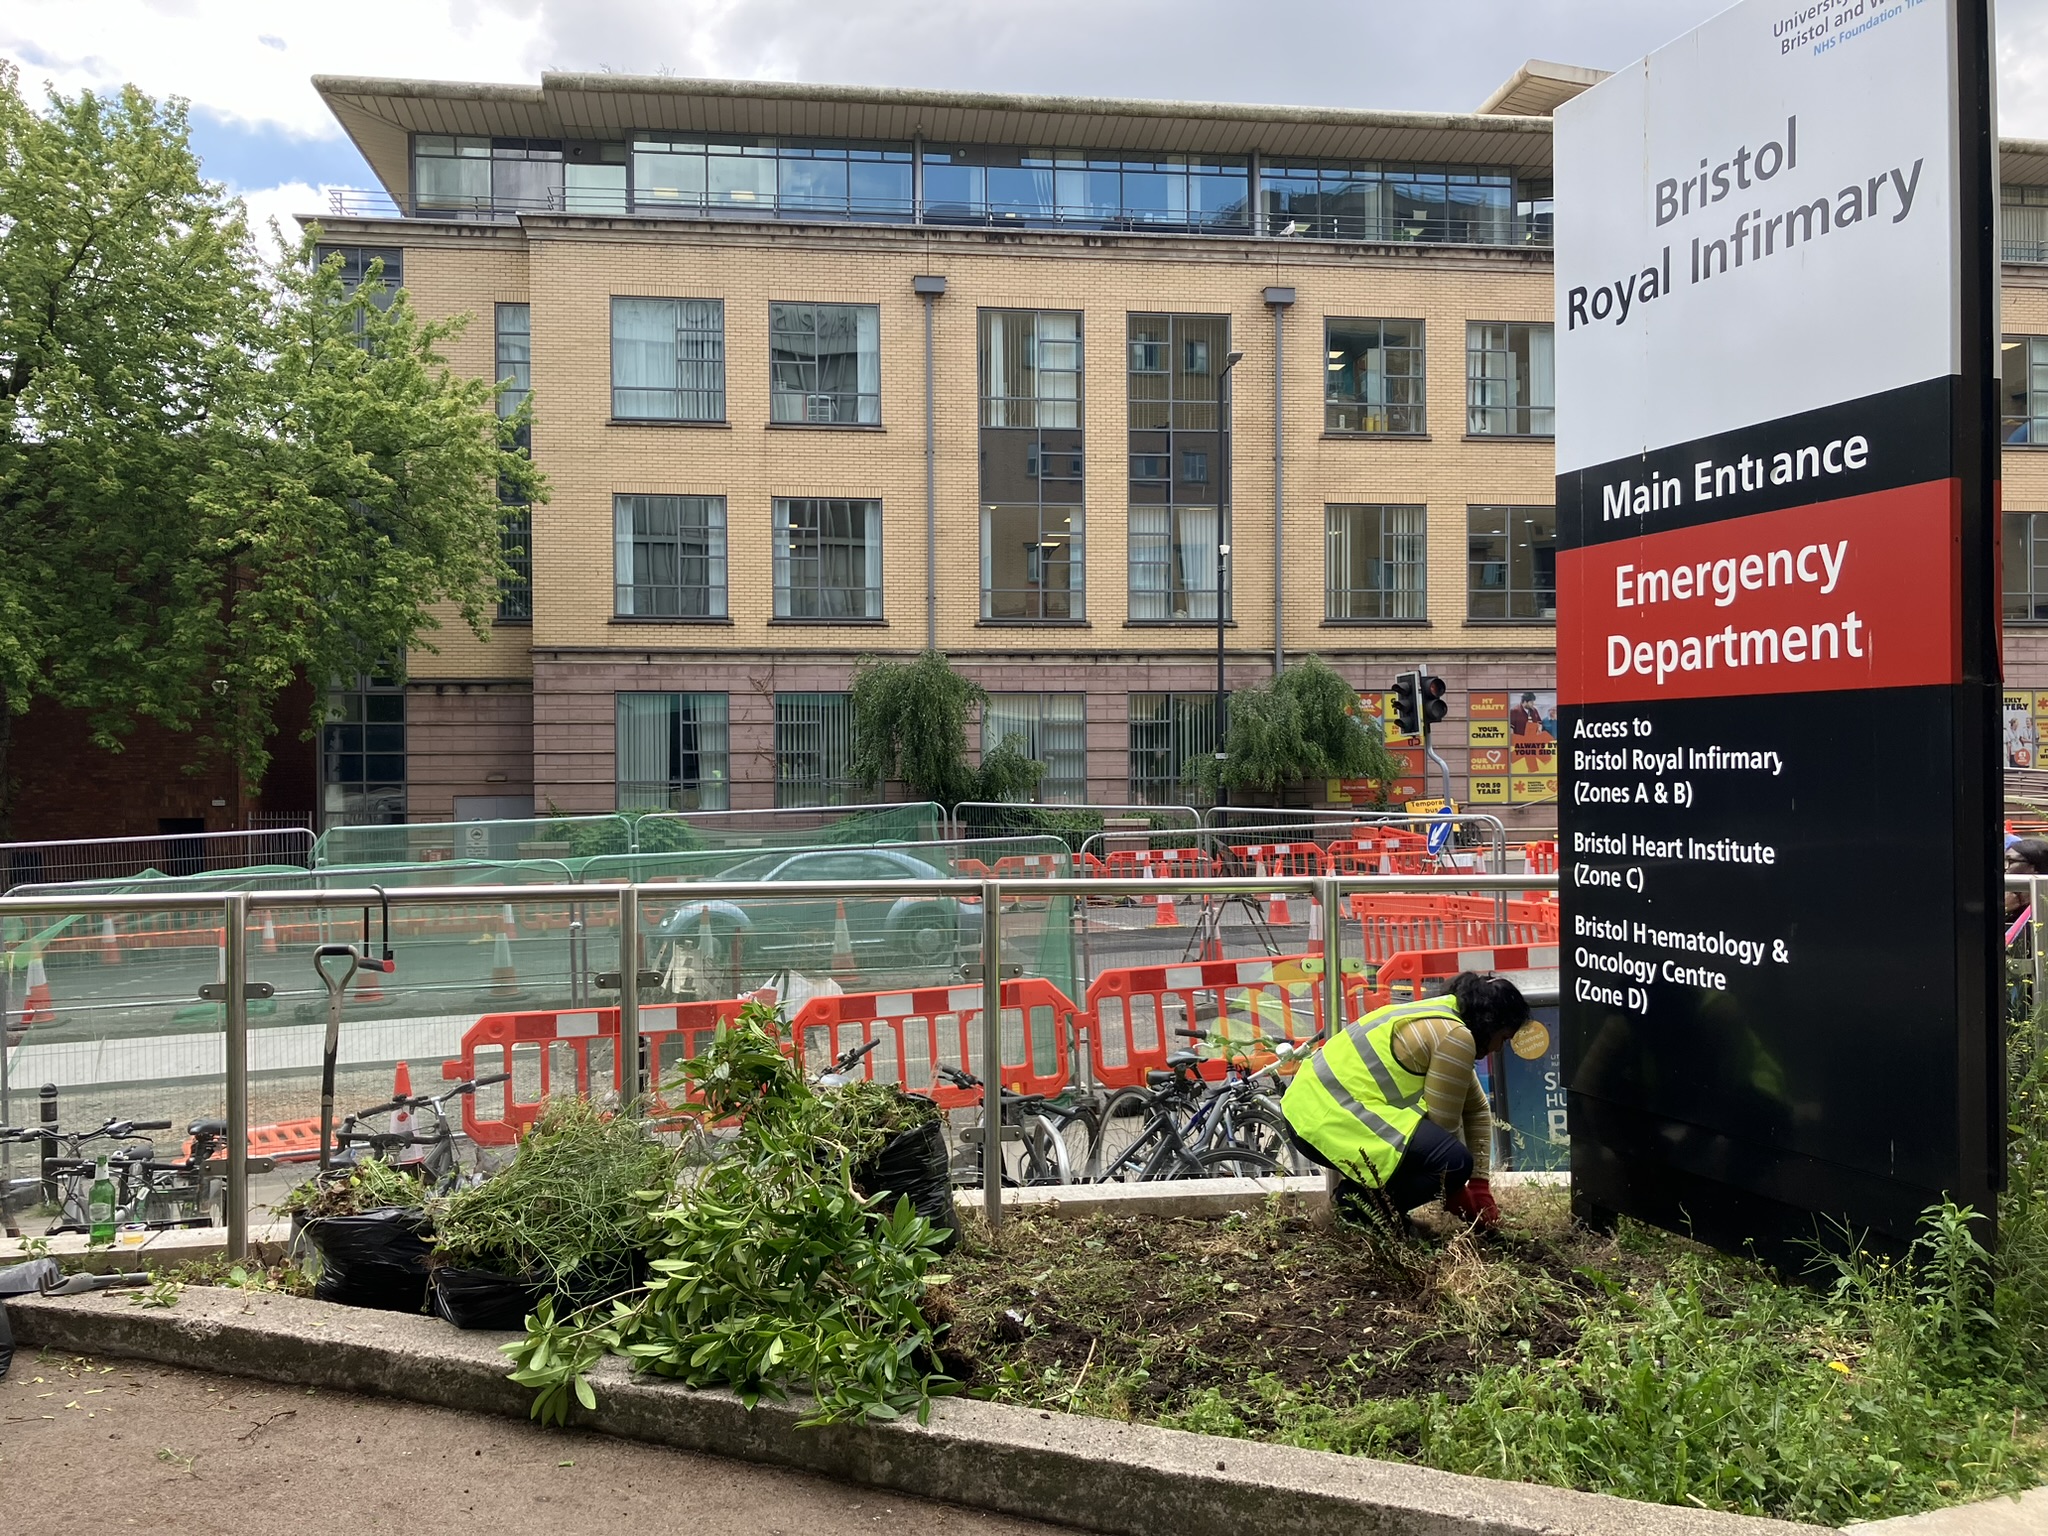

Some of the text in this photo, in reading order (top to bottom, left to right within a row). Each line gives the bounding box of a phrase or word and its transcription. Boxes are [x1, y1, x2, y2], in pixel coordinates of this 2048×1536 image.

[1781, 0, 1863, 55] Bristol and
[1813, 5, 1902, 56] NHS Foundation
[1656, 115, 1797, 228] Bristol
[1568, 158, 1924, 331] Royal Infirmary
[1603, 471, 1681, 521] Main
[1616, 540, 1849, 607] Emergency
[1608, 611, 1863, 684] Department
[1573, 717, 1653, 739] Access to
[1574, 746, 1783, 776] Bristol Royal Infirmary
[1574, 781, 1630, 806] (Zones
[1634, 782, 1650, 804] A
[1653, 781, 1669, 804] &
[1673, 780, 1693, 808] B)
[1574, 832, 1776, 865] Bristol Heart Institute
[1574, 861, 1644, 893] (Zone C)
[1574, 914, 1628, 942] Bristol
[1771, 938, 1790, 964] &
[1575, 947, 1727, 990] Oncology Centre
[1575, 977, 1648, 1014] (Zone D)
[1520, 1040, 1545, 1055] crusher
